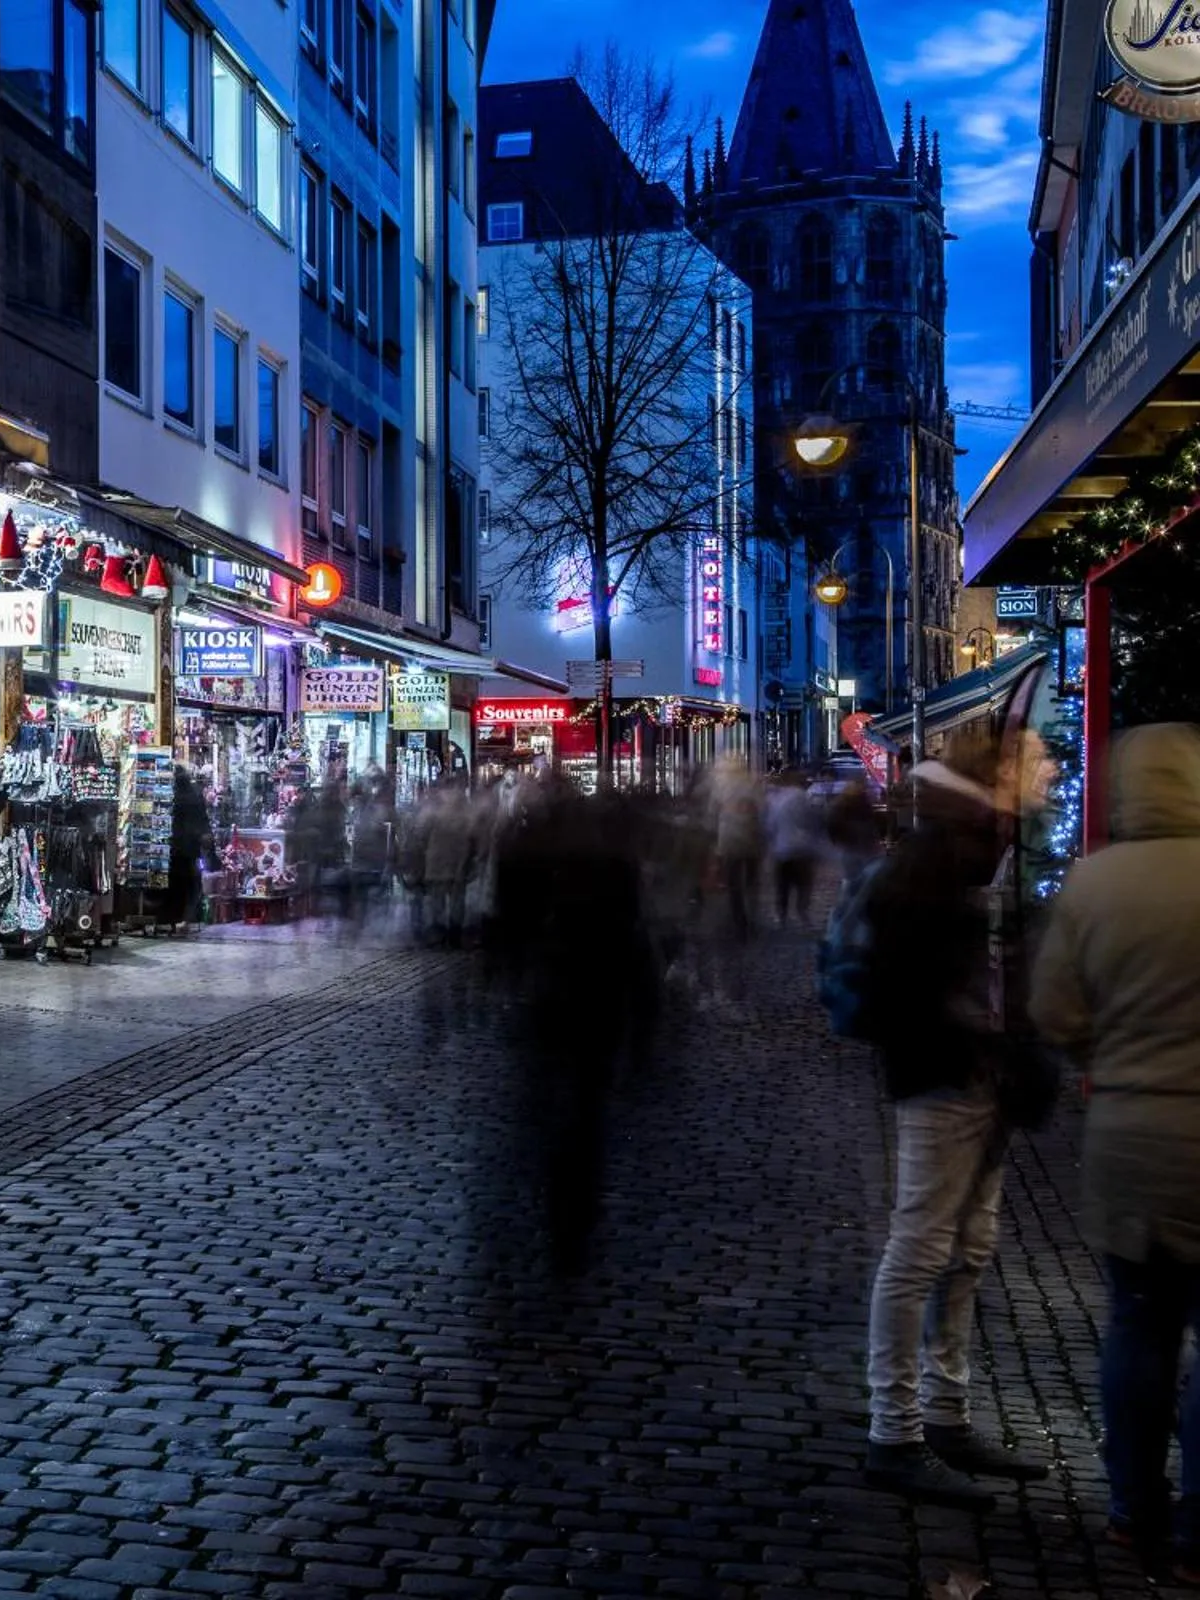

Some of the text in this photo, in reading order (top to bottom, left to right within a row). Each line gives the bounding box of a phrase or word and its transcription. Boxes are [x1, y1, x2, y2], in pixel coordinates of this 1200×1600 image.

[703, 537, 722, 652] HOTEL
[1001, 601, 1034, 612] SION
[184, 630, 254, 648] KIOSK
[305, 671, 380, 682] GOLD
[397, 676, 447, 686] GOLD
[306, 694, 378, 703] UHREN
[397, 695, 446, 703] UHREN
[483, 704, 564, 720] Souvenirs
